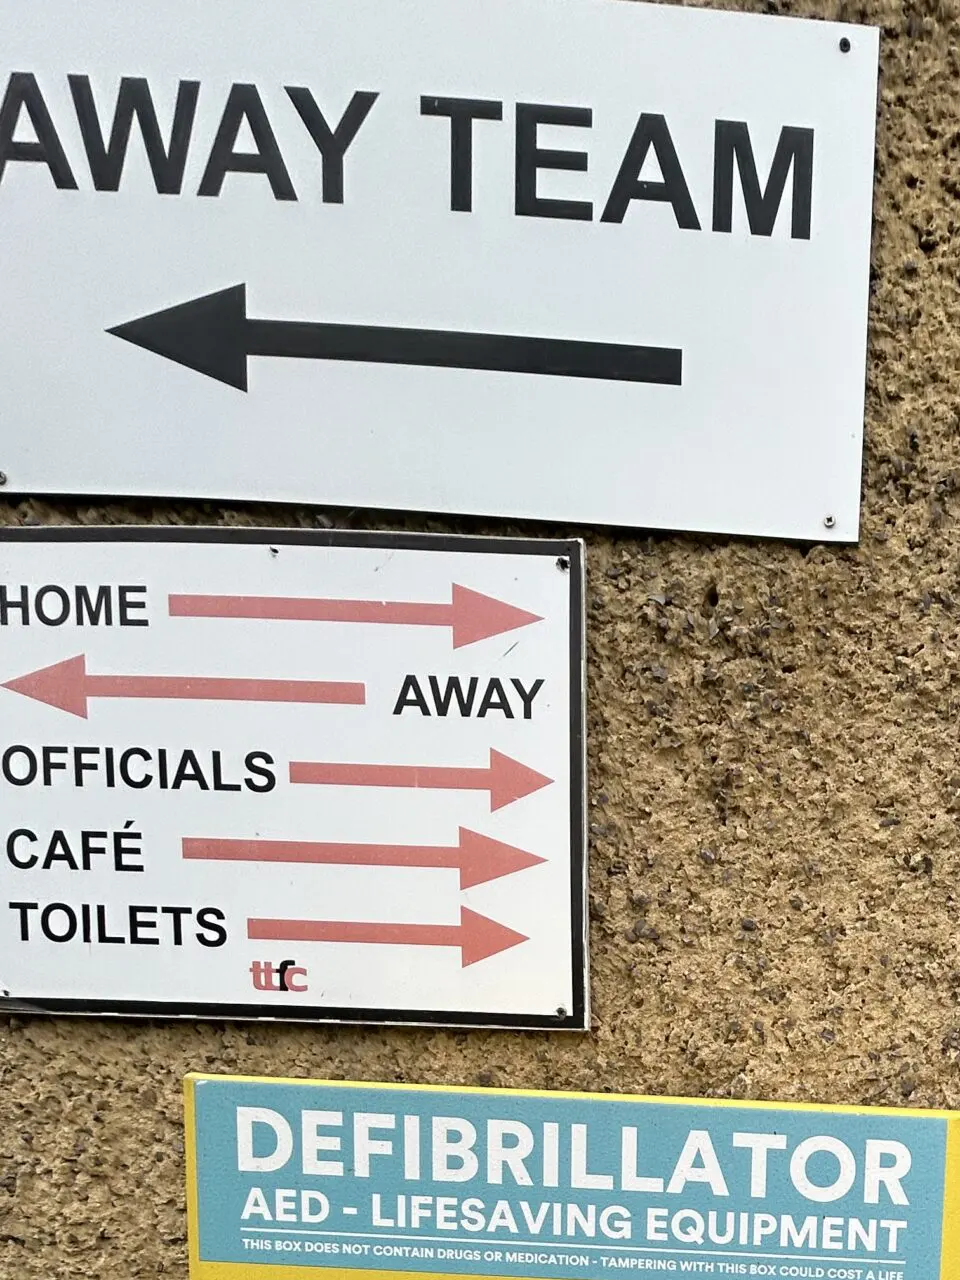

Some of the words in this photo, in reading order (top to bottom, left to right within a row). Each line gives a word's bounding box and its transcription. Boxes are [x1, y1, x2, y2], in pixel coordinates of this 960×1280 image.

[0, 71, 380, 204] AWAY
[420, 95, 814, 240] TEAM
[0, 585, 149, 627] HOME
[392, 675, 545, 719] AWAY
[2, 745, 276, 793] OFFICIALS
[6, 821, 145, 872] CAFÉ
[9, 902, 227, 947] TOILETS
[236, 1107, 912, 1205] DEFIBRILLATOR
[241, 1188, 330, 1224] AED
[342, 1208, 358, 1216] -
[371, 1192, 632, 1240] LIFESAVING
[647, 1207, 907, 1253] EQUIPMENT
[242, 1239, 272, 1250] THIS
[275, 1240, 301, 1252] BOX
[305, 1242, 340, 1254] DOES
[342, 1244, 370, 1255] NOT
[373, 1245, 434, 1258] CONTAIN
[438, 1248, 481, 1261] DRUGS
[484, 1251, 502, 1262] OR
[505, 1252, 589, 1266] MEDICATION
[600, 1257, 676, 1271] TAMPERING
[679, 1261, 714, 1273] WITH
[718, 1262, 747, 1274] THIS
[749, 1264, 776, 1276] BOX
[780, 1266, 825, 1278] COULD
[828, 1268, 864, 1280] COST
[865, 1270, 875, 1280] A
